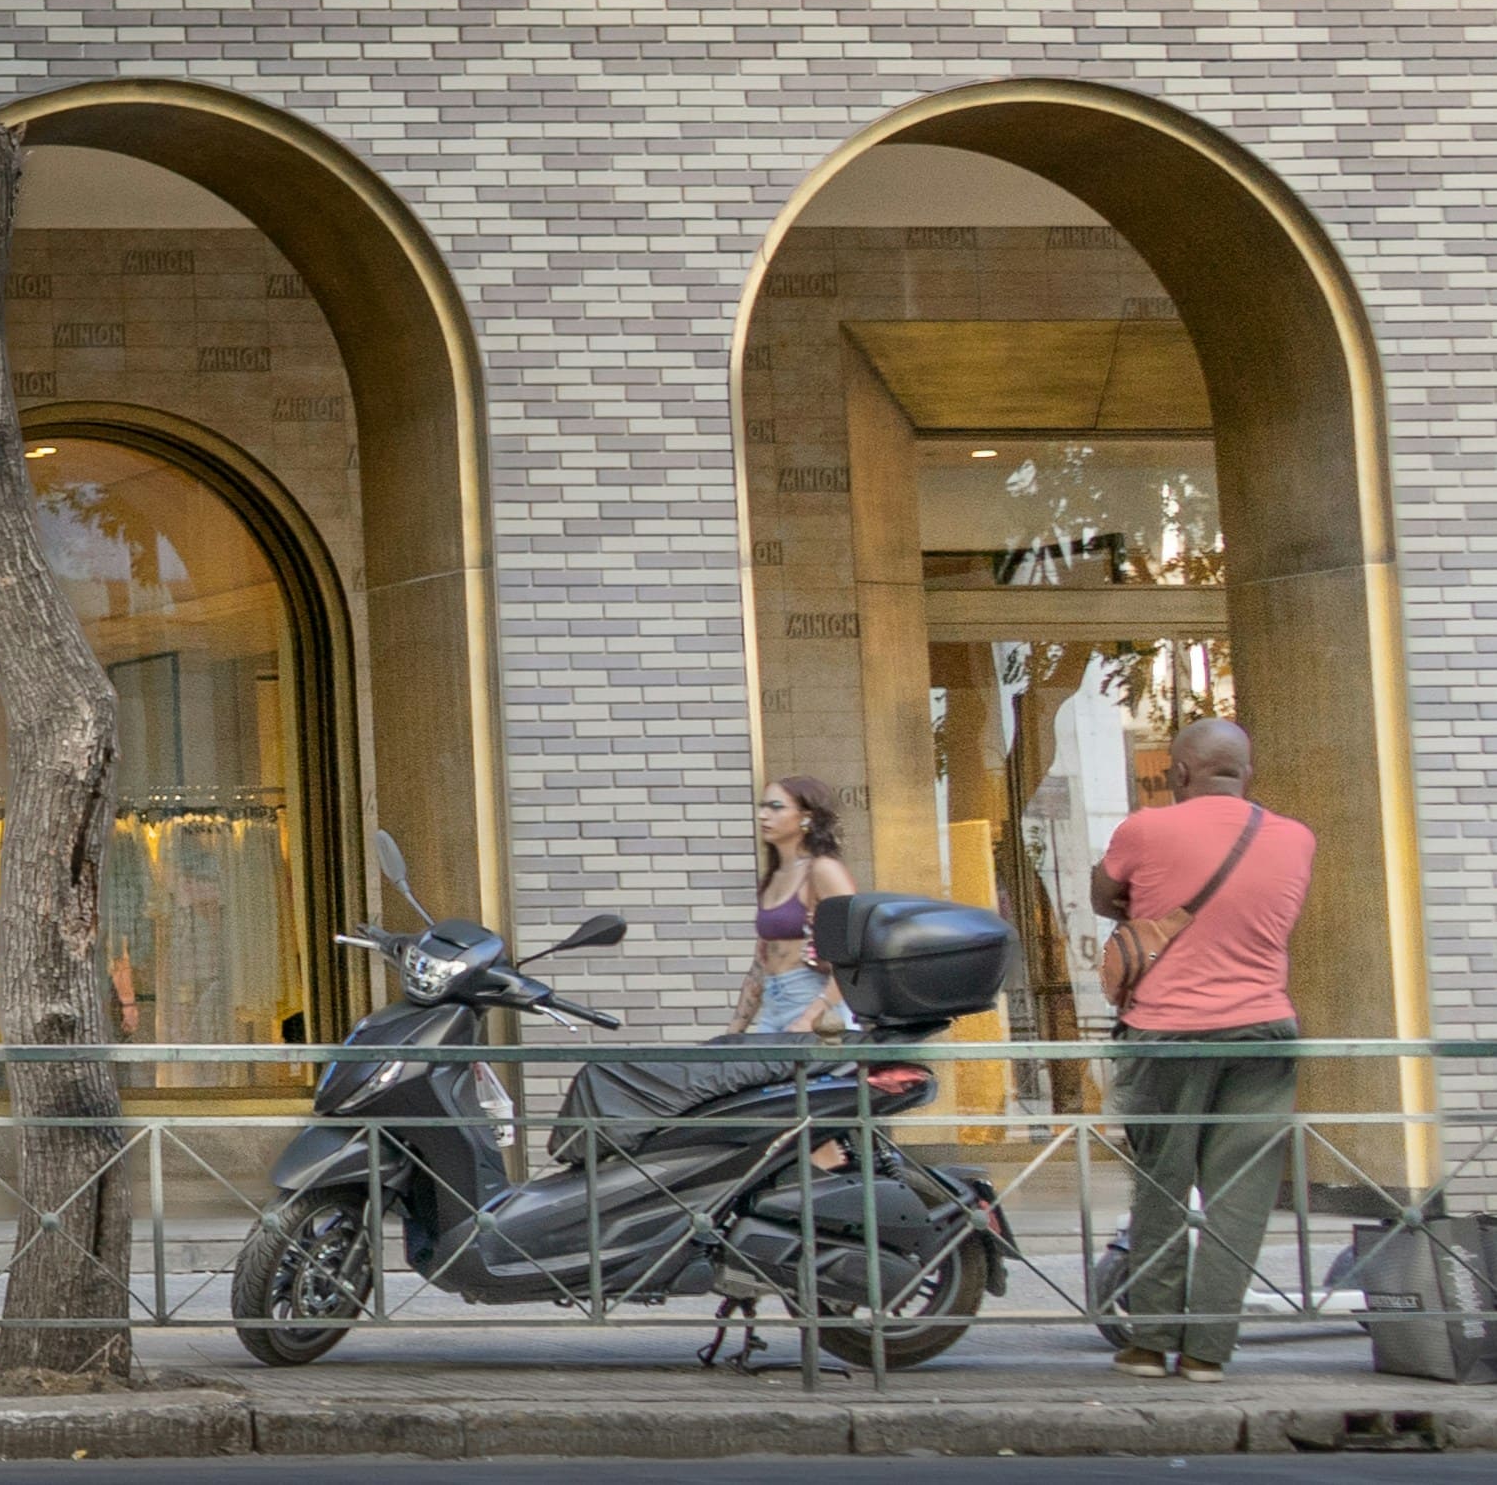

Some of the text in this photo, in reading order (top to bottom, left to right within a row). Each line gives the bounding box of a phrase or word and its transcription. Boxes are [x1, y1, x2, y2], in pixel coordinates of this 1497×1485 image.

[6, 275, 52, 298] NION
[269, 275, 304, 297] MIN
[54, 323, 126, 346] MINION
[198, 348, 271, 371] MINION
[778, 467, 849, 491] MINION
[785, 614, 858, 638] MINION
